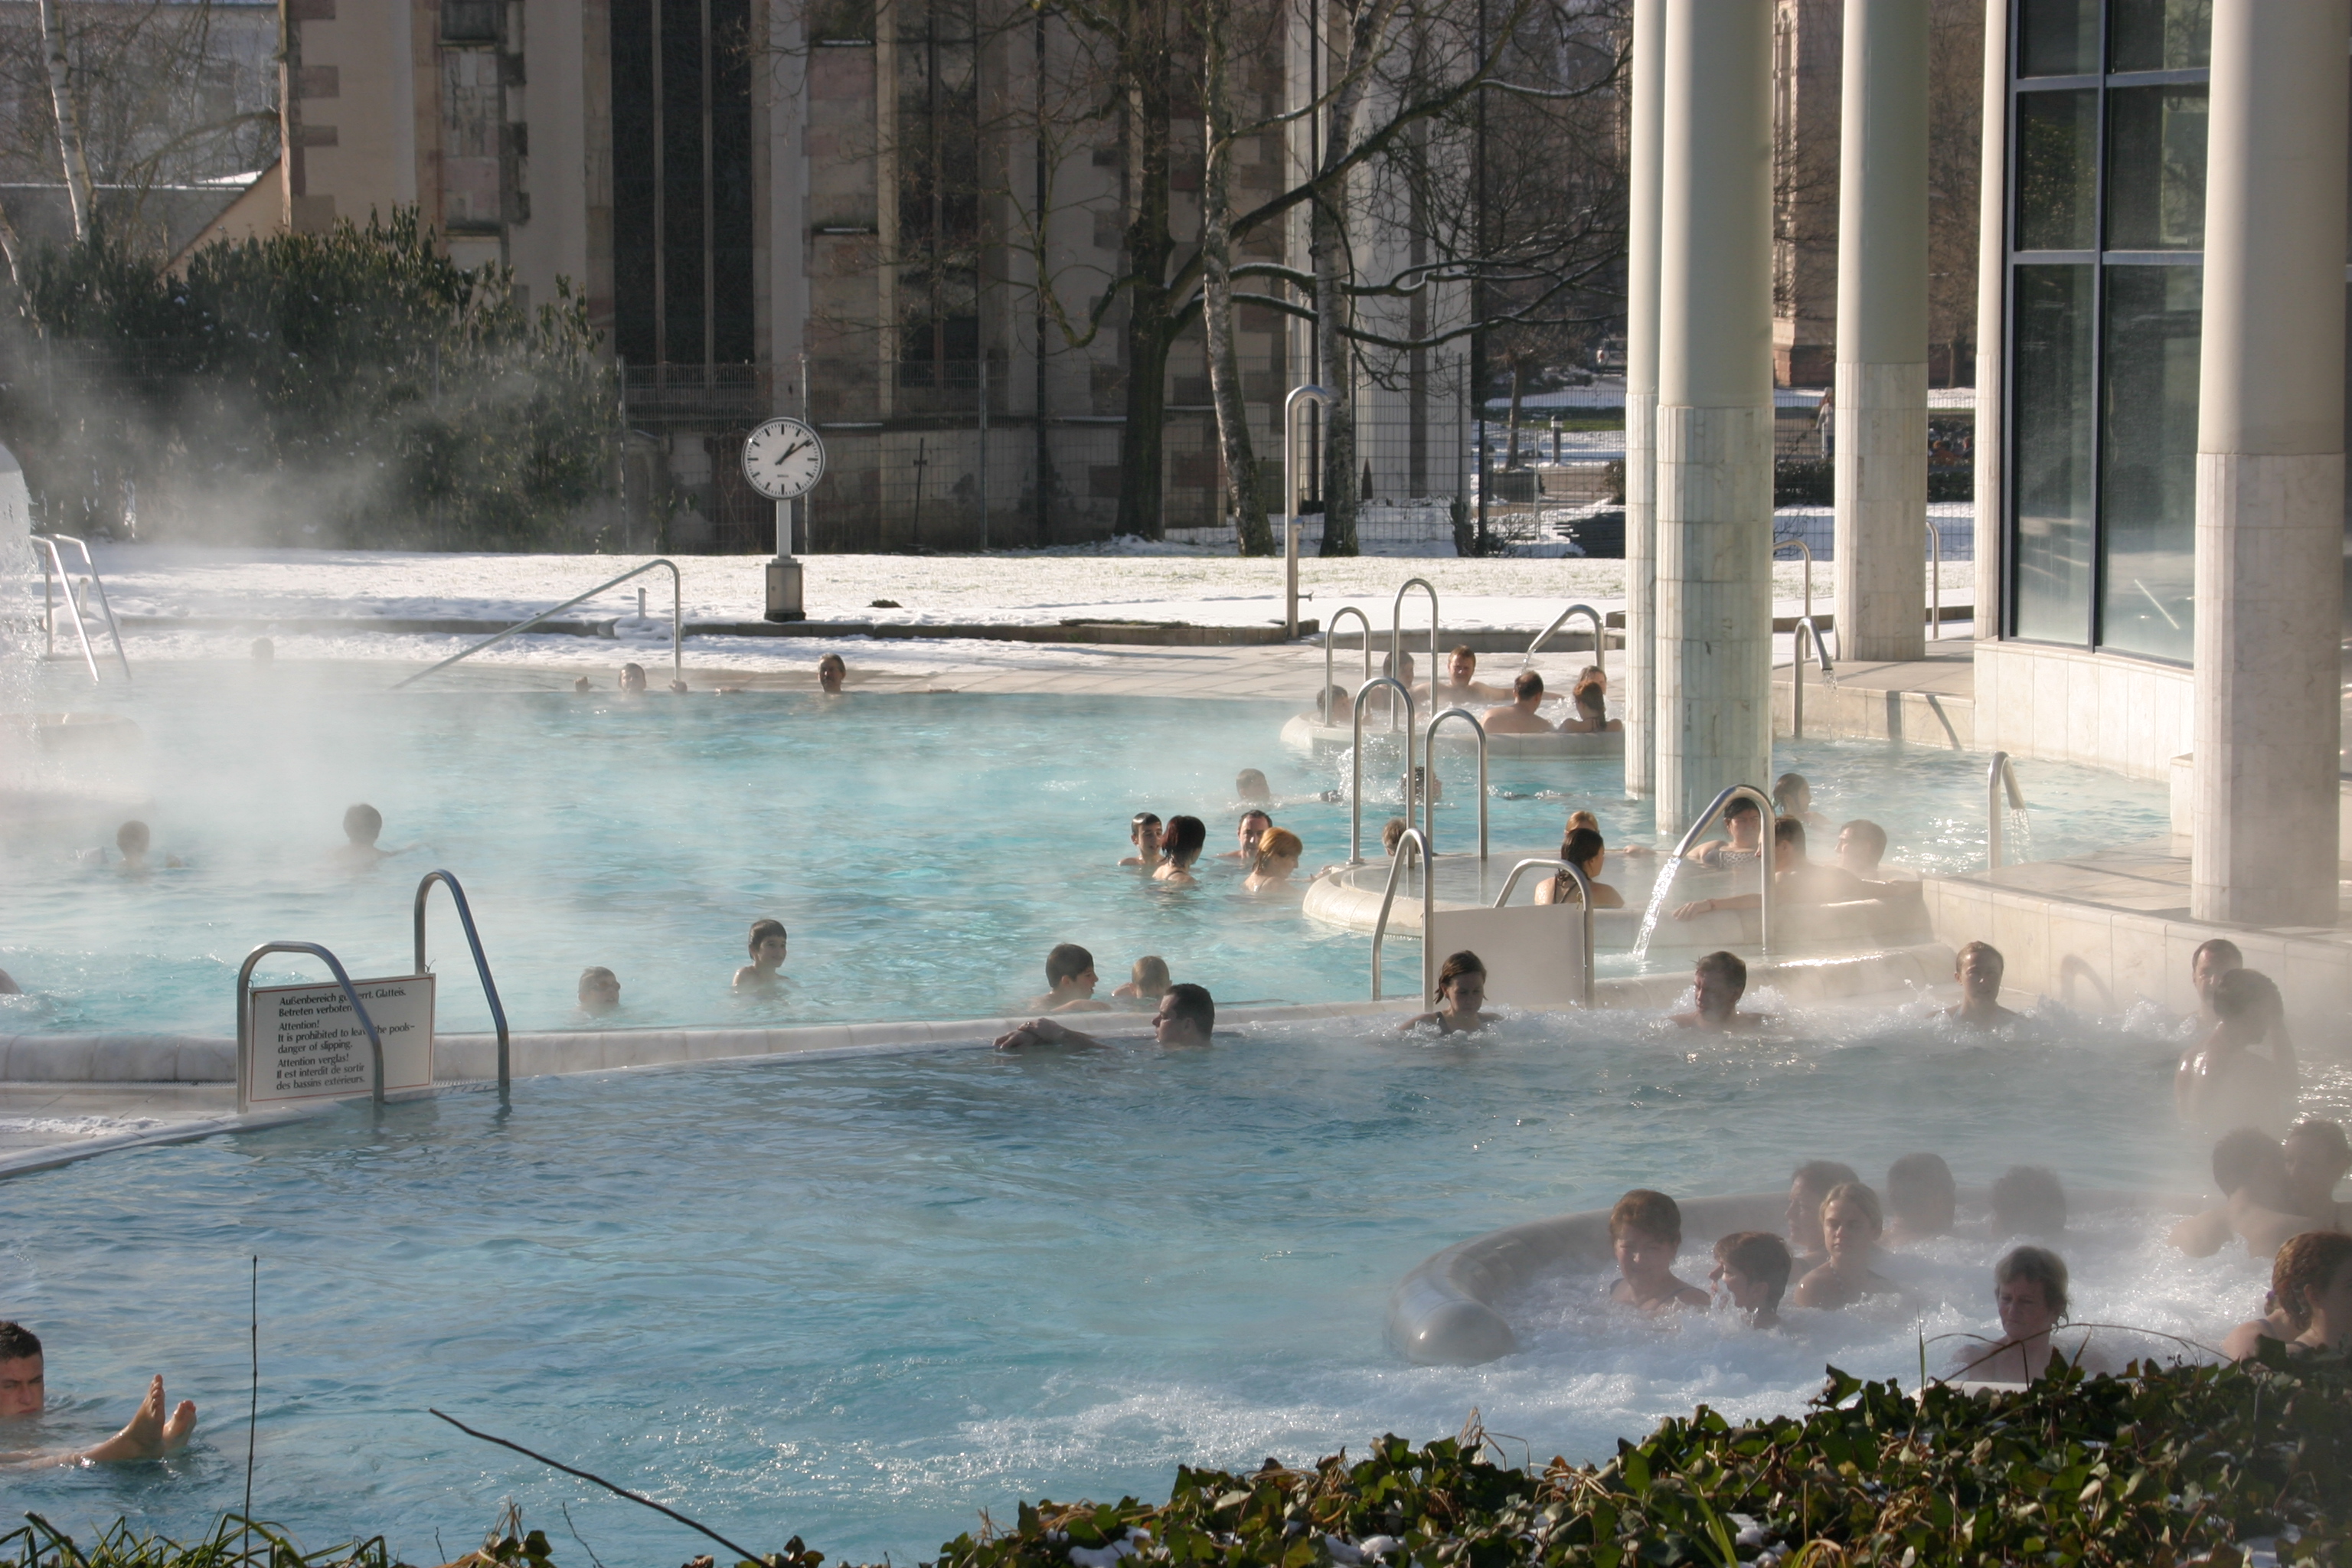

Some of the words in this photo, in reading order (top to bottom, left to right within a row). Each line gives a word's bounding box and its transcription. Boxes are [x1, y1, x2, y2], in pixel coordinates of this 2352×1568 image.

[279, 993, 336, 1006] Außenbereich
[376, 987, 407, 998] Glatteis.
[279, 1007, 314, 1018] Betreten
[316, 1004, 352, 1014] verboten
[279, 1020, 320, 1031] Attention!
[278, 1034, 284, 1043] It
[286, 1032, 293, 1042] is
[296, 1029, 338, 1043] prohibited
[278, 1044, 306, 1055] danger
[309, 1042, 318, 1051] of
[320, 1040, 353, 1051] slipping.
[277, 1057, 315, 1068] Attention
[318, 1054, 349, 1065] verglas!
[284, 1069, 296, 1079] est
[299, 1066, 328, 1077] interdit
[331, 1064, 341, 1073] de
[344, 1062, 365, 1073] sortir
[276, 1080, 291, 1090] des
[293, 1078, 322, 1089] bassins
